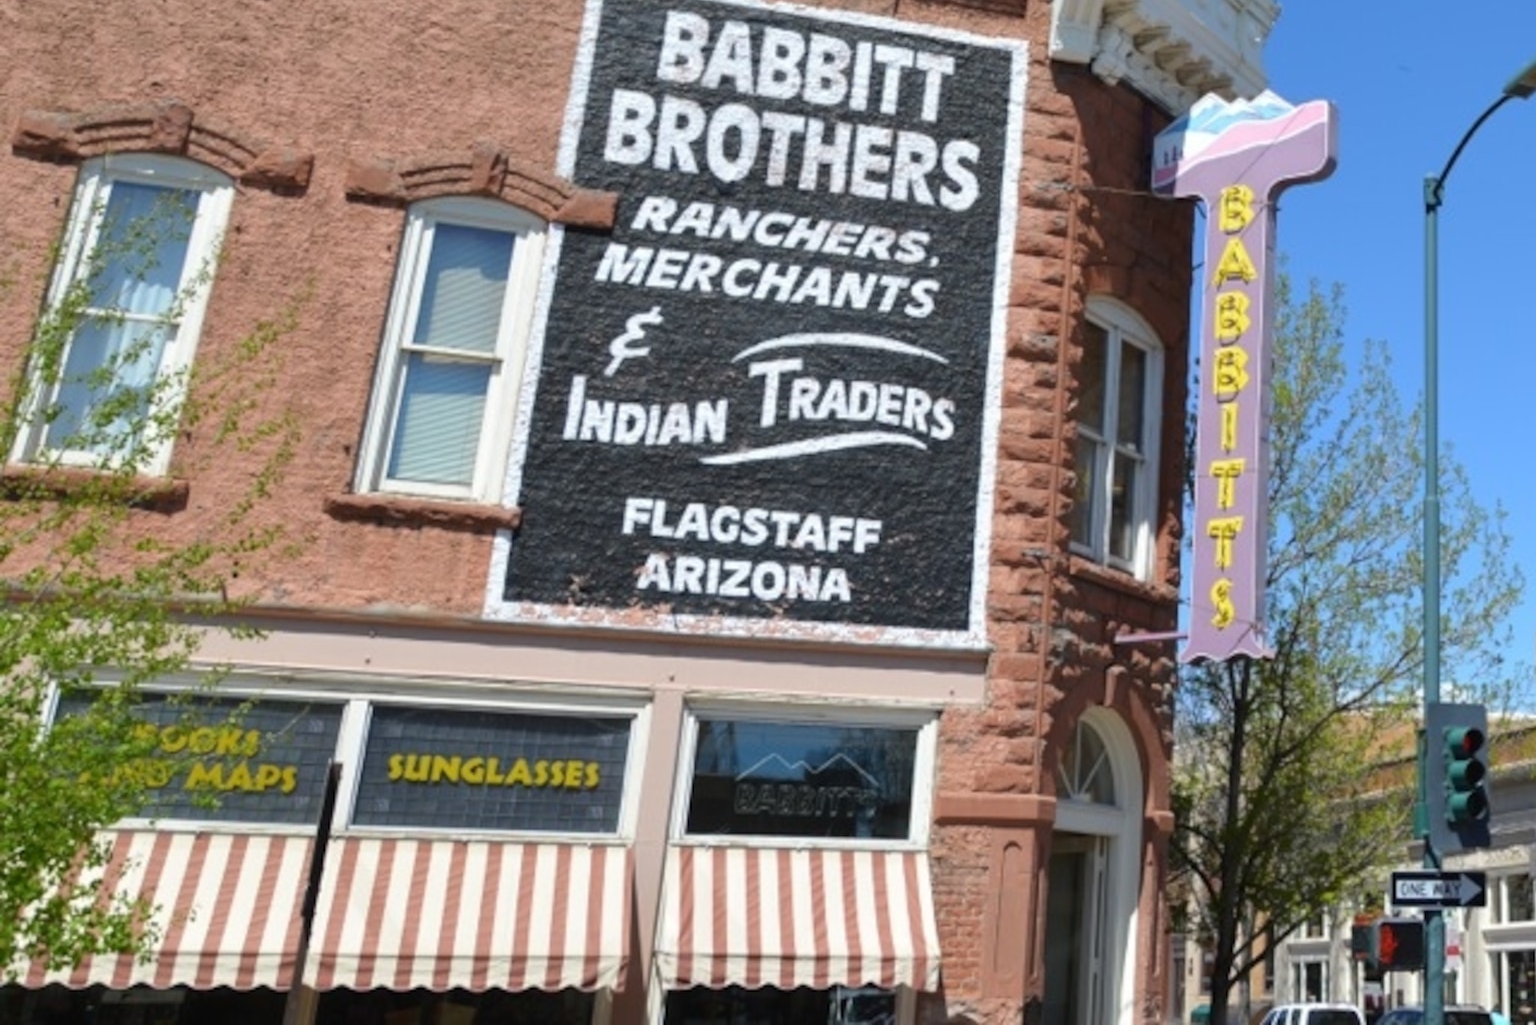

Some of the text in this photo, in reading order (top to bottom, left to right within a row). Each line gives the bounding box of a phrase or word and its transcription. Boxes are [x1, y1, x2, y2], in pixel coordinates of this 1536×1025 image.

[656, 10, 957, 124] BABBITT
[603, 89, 982, 212] BROTHERS
[594, 243, 940, 319] MERCHANTS
[604, 307, 664, 377] &
[562, 357, 956, 446] INDIAN TRADERS
[1204, 183, 1259, 631] BABBITTS
[621, 497, 883, 554] FLAGSTAFF
[636, 552, 852, 602] ARIZONA
[183, 761, 298, 794] MAPS
[387, 753, 600, 790] SUNGLASSES
[1400, 882, 1462, 896] ONE WAY
